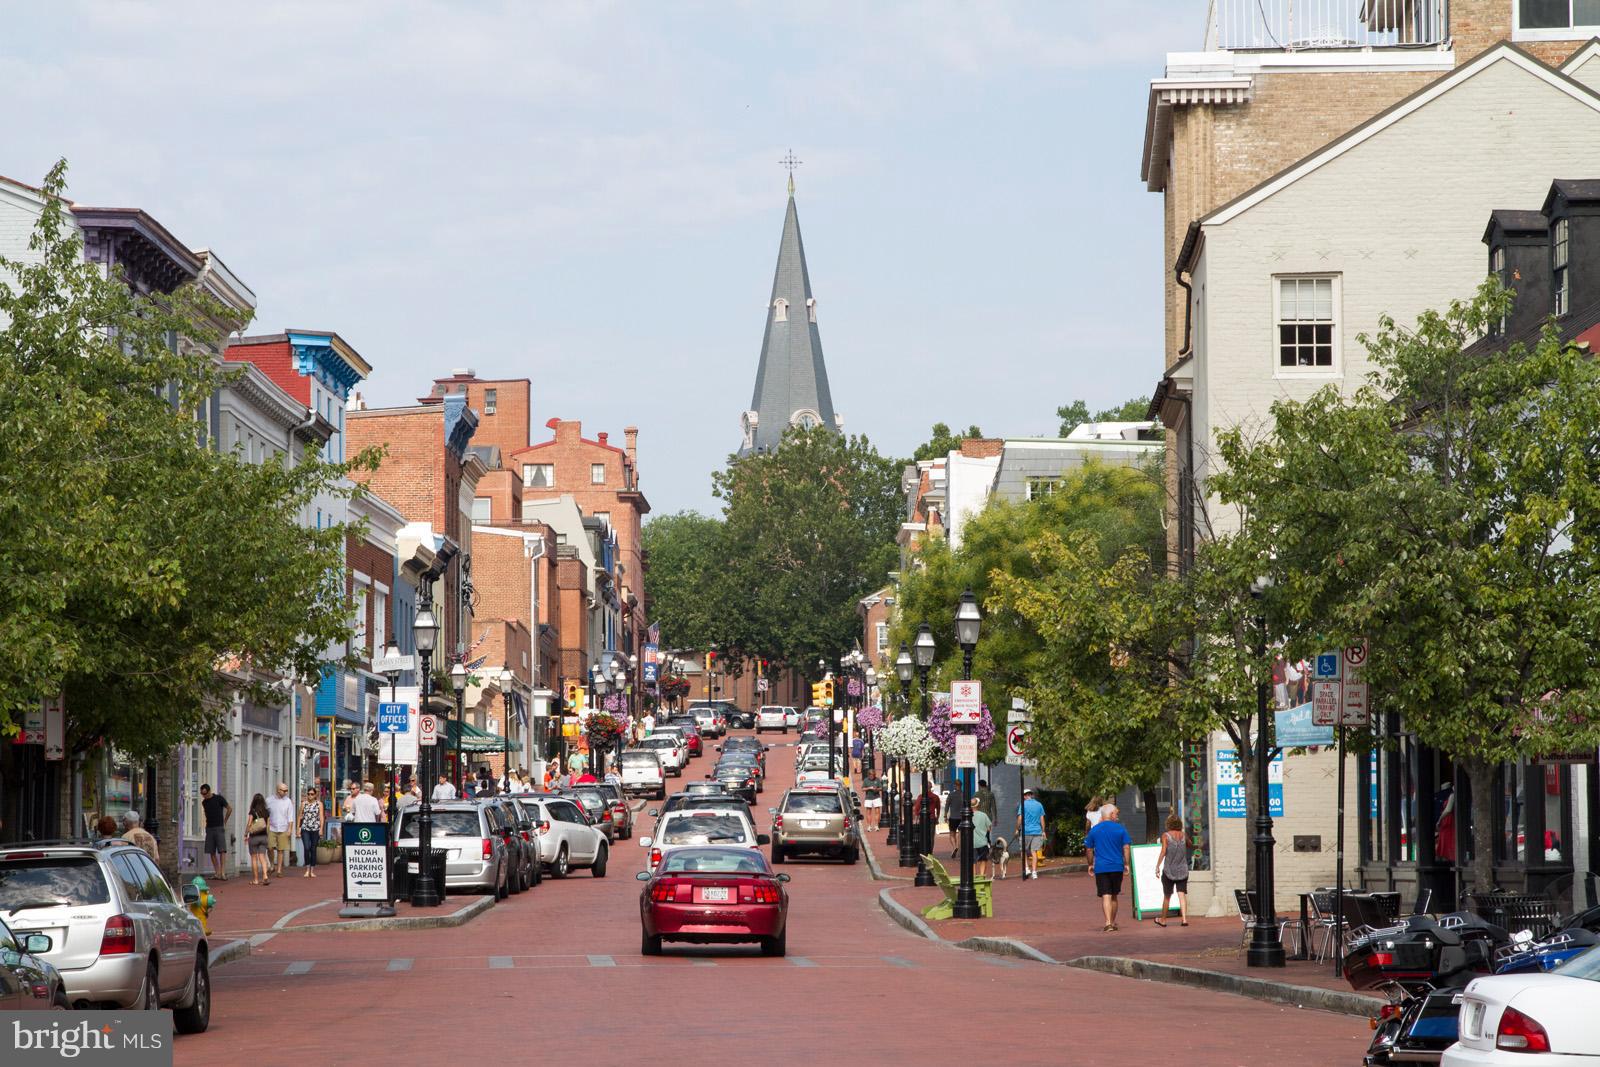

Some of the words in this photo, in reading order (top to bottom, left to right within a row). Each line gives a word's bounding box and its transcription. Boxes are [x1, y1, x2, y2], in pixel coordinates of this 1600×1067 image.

[395, 655, 411, 664] STREET
[386, 705, 401, 714] CITY
[380, 715, 407, 723] OFFICES
[1541, 752, 1566, 760] Coffee
[351, 871, 382, 879] GARAGE
